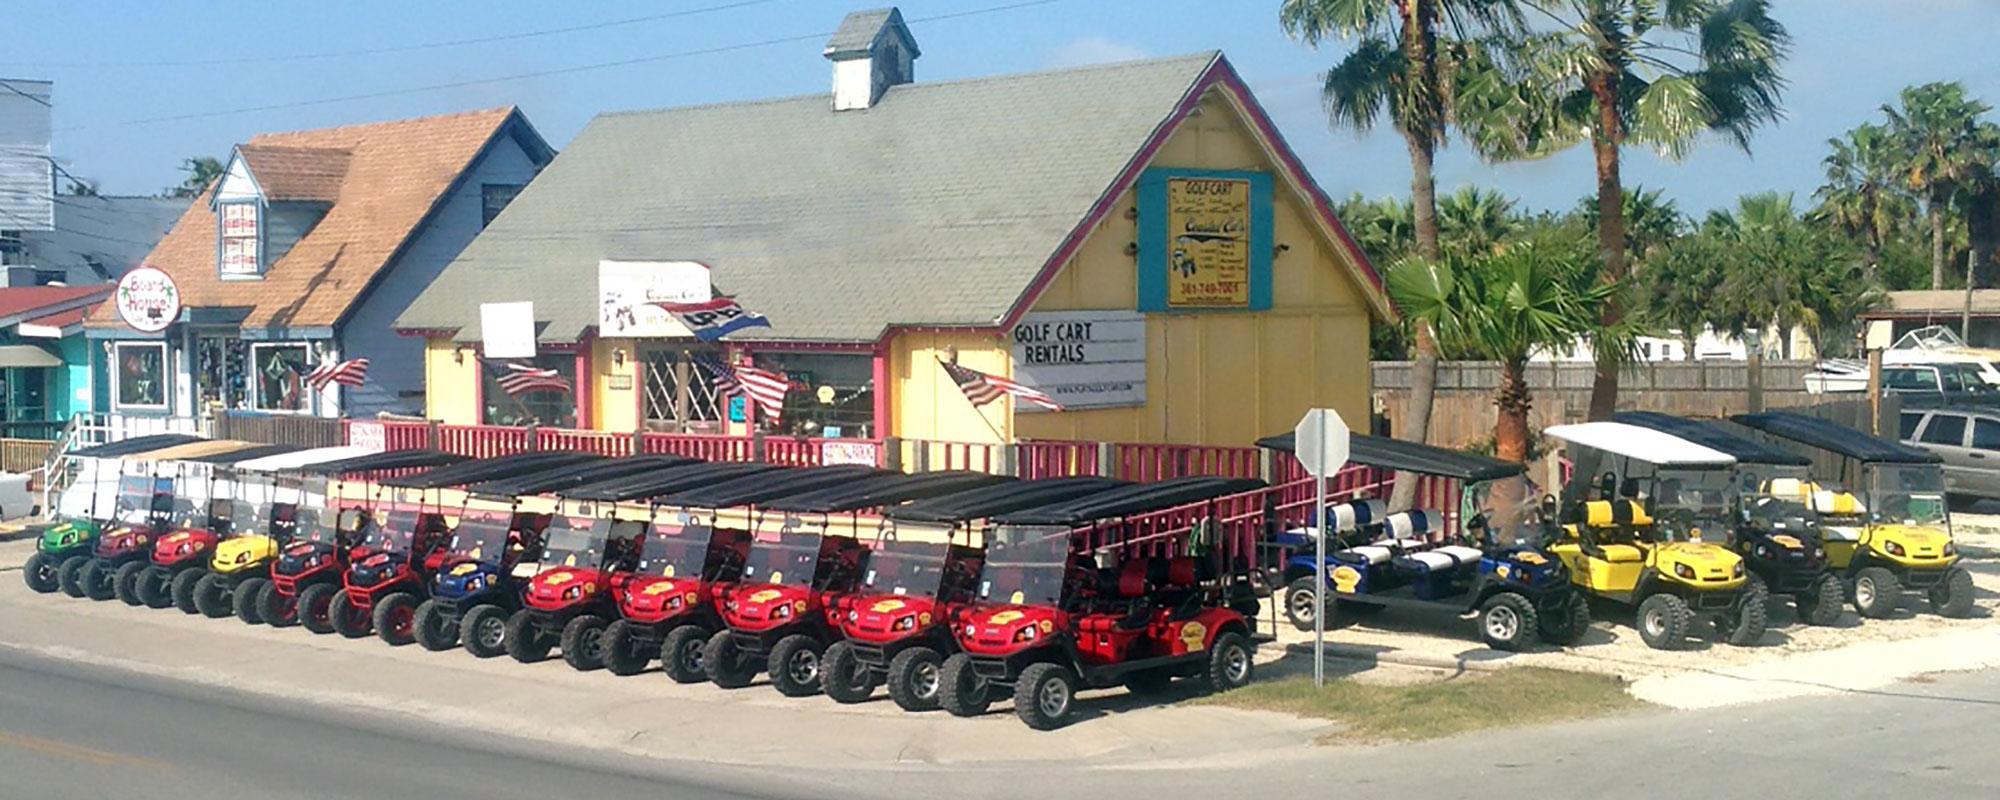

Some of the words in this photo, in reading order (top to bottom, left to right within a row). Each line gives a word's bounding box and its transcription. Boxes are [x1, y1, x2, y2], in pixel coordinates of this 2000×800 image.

[1210, 181, 1233, 196] CART
[130, 274, 166, 293] Board
[1014, 324, 1050, 343] GOLF
[1056, 322, 1092, 341] CART
[1025, 344, 1084, 364] RENTALS
